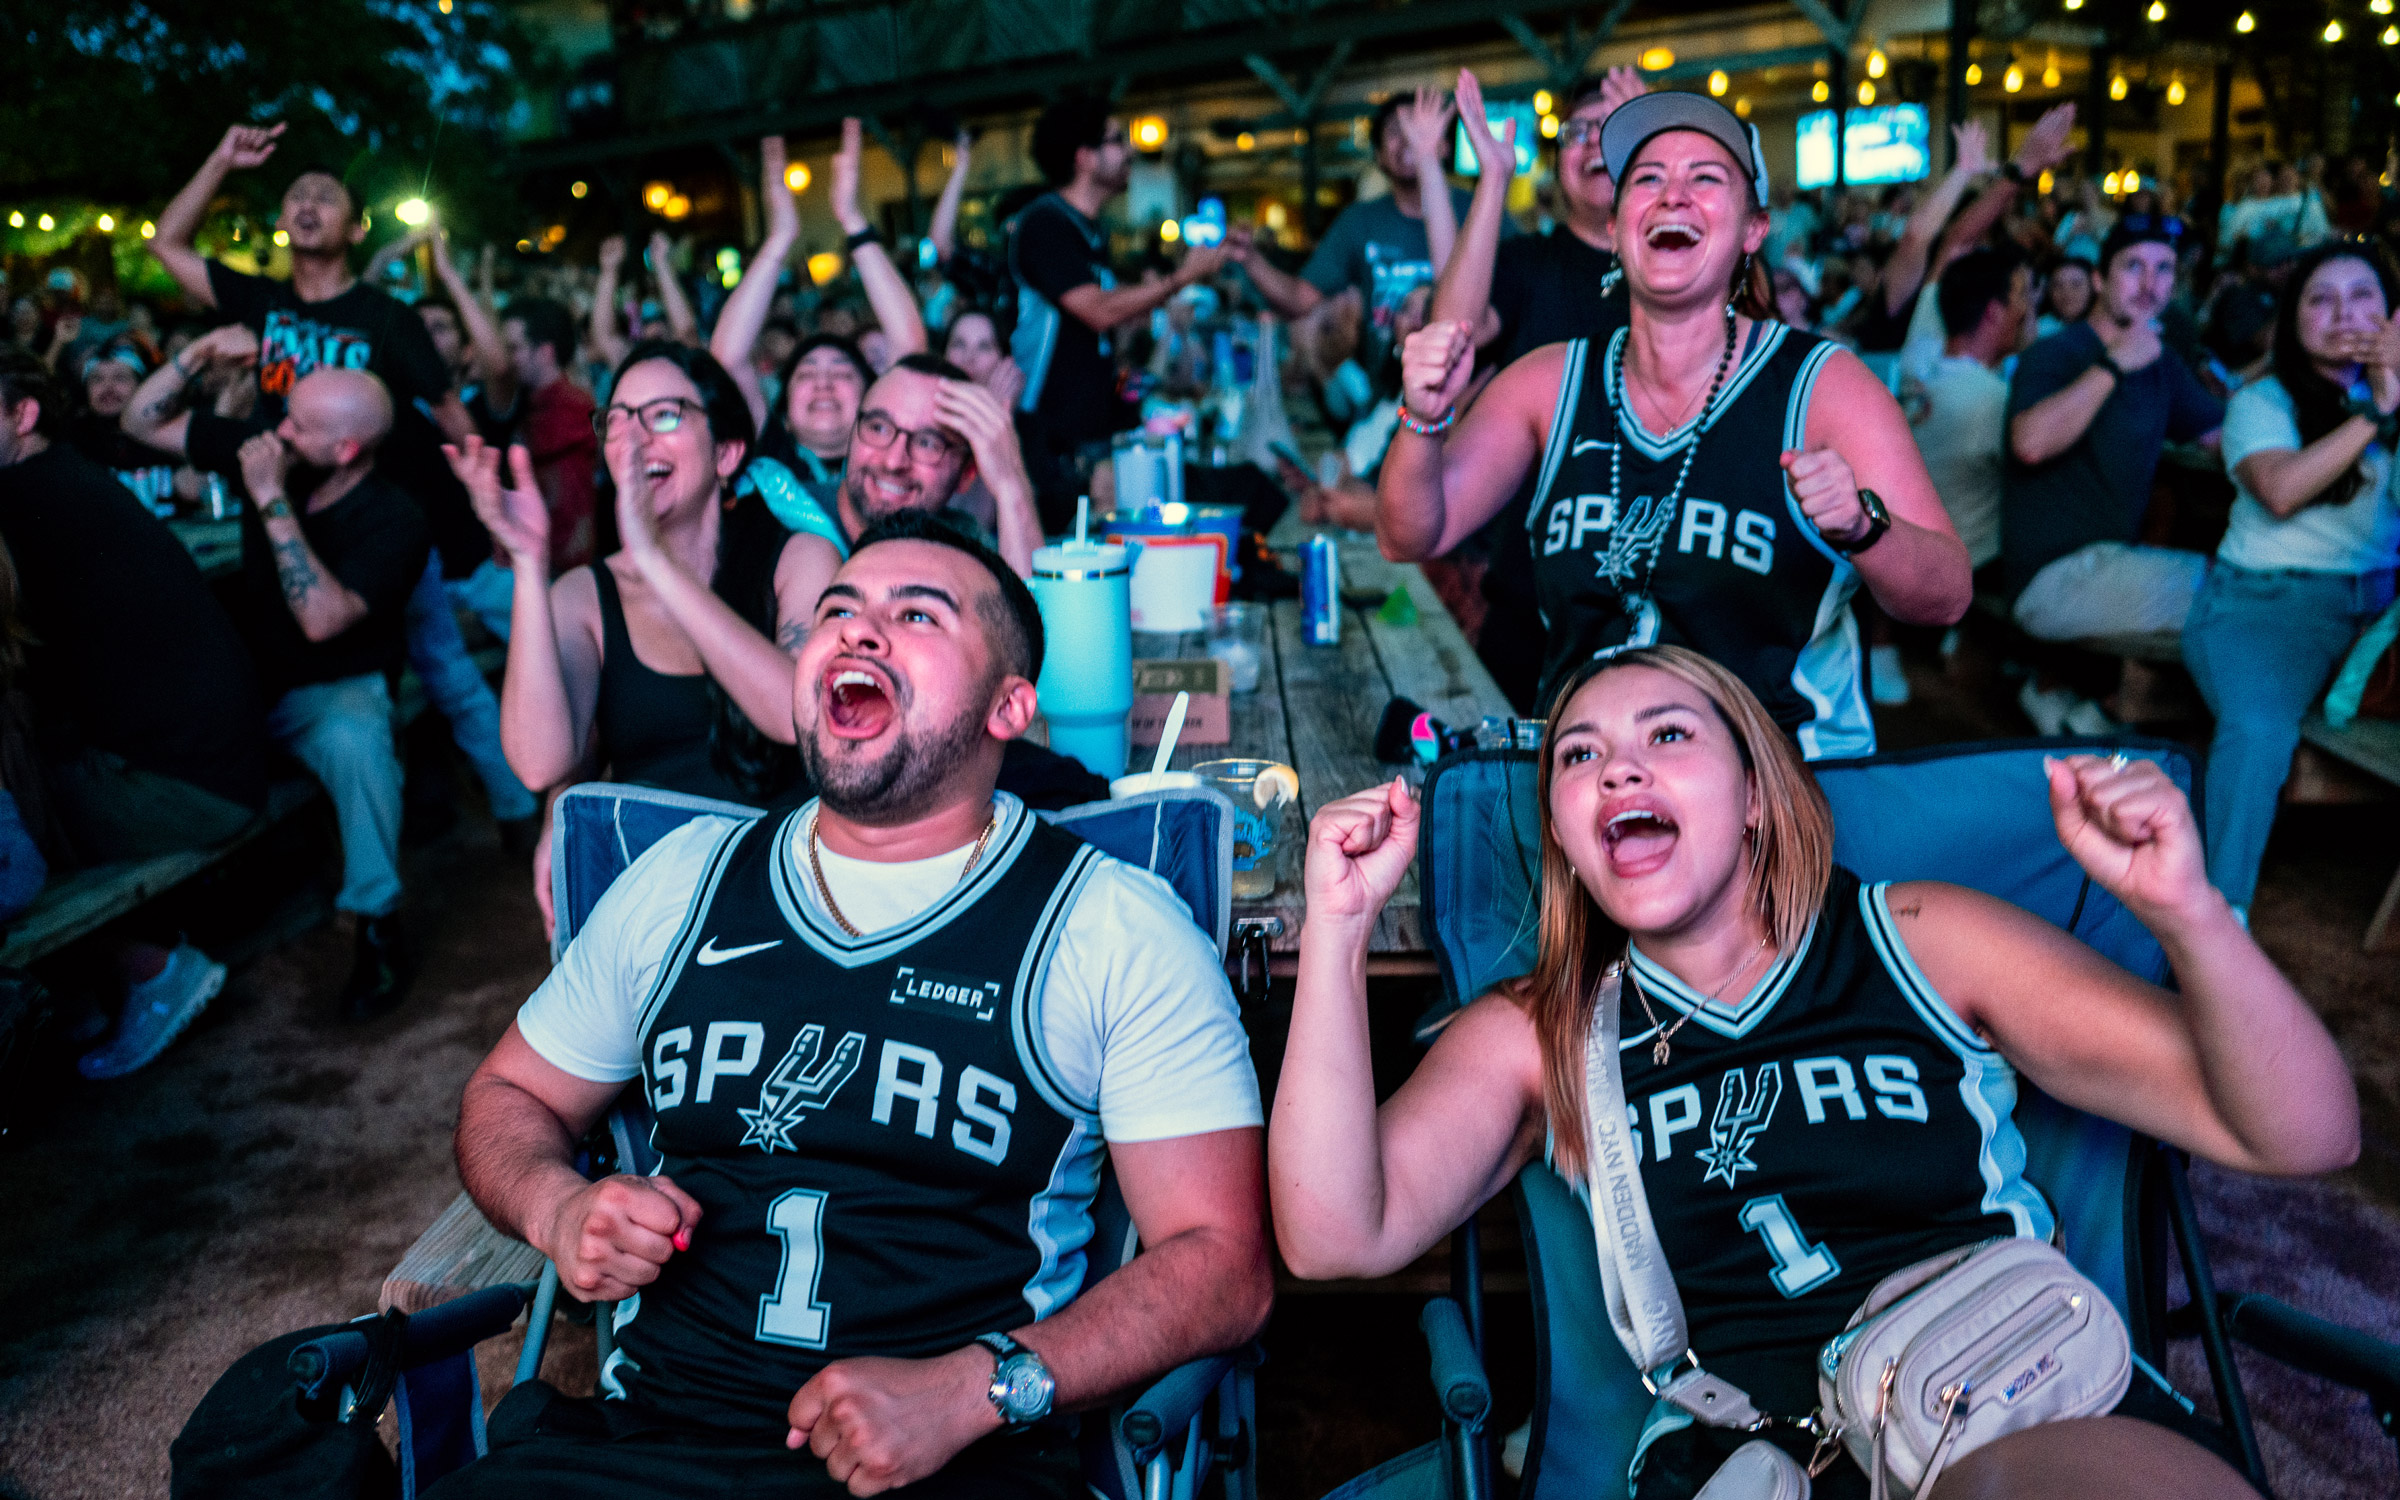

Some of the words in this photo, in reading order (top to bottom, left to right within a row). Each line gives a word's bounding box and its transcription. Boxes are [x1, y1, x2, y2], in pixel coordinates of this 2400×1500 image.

[1543, 493, 1776, 586] SPURS
[905, 977, 984, 1009] LEDGER
[652, 1020, 1017, 1167] SPURS
[1598, 1117, 1625, 1170] NYC
[755, 1187, 832, 1351] 1
[1609, 1173, 1651, 1271] MADDEN
[1737, 1193, 1841, 1299] 1
